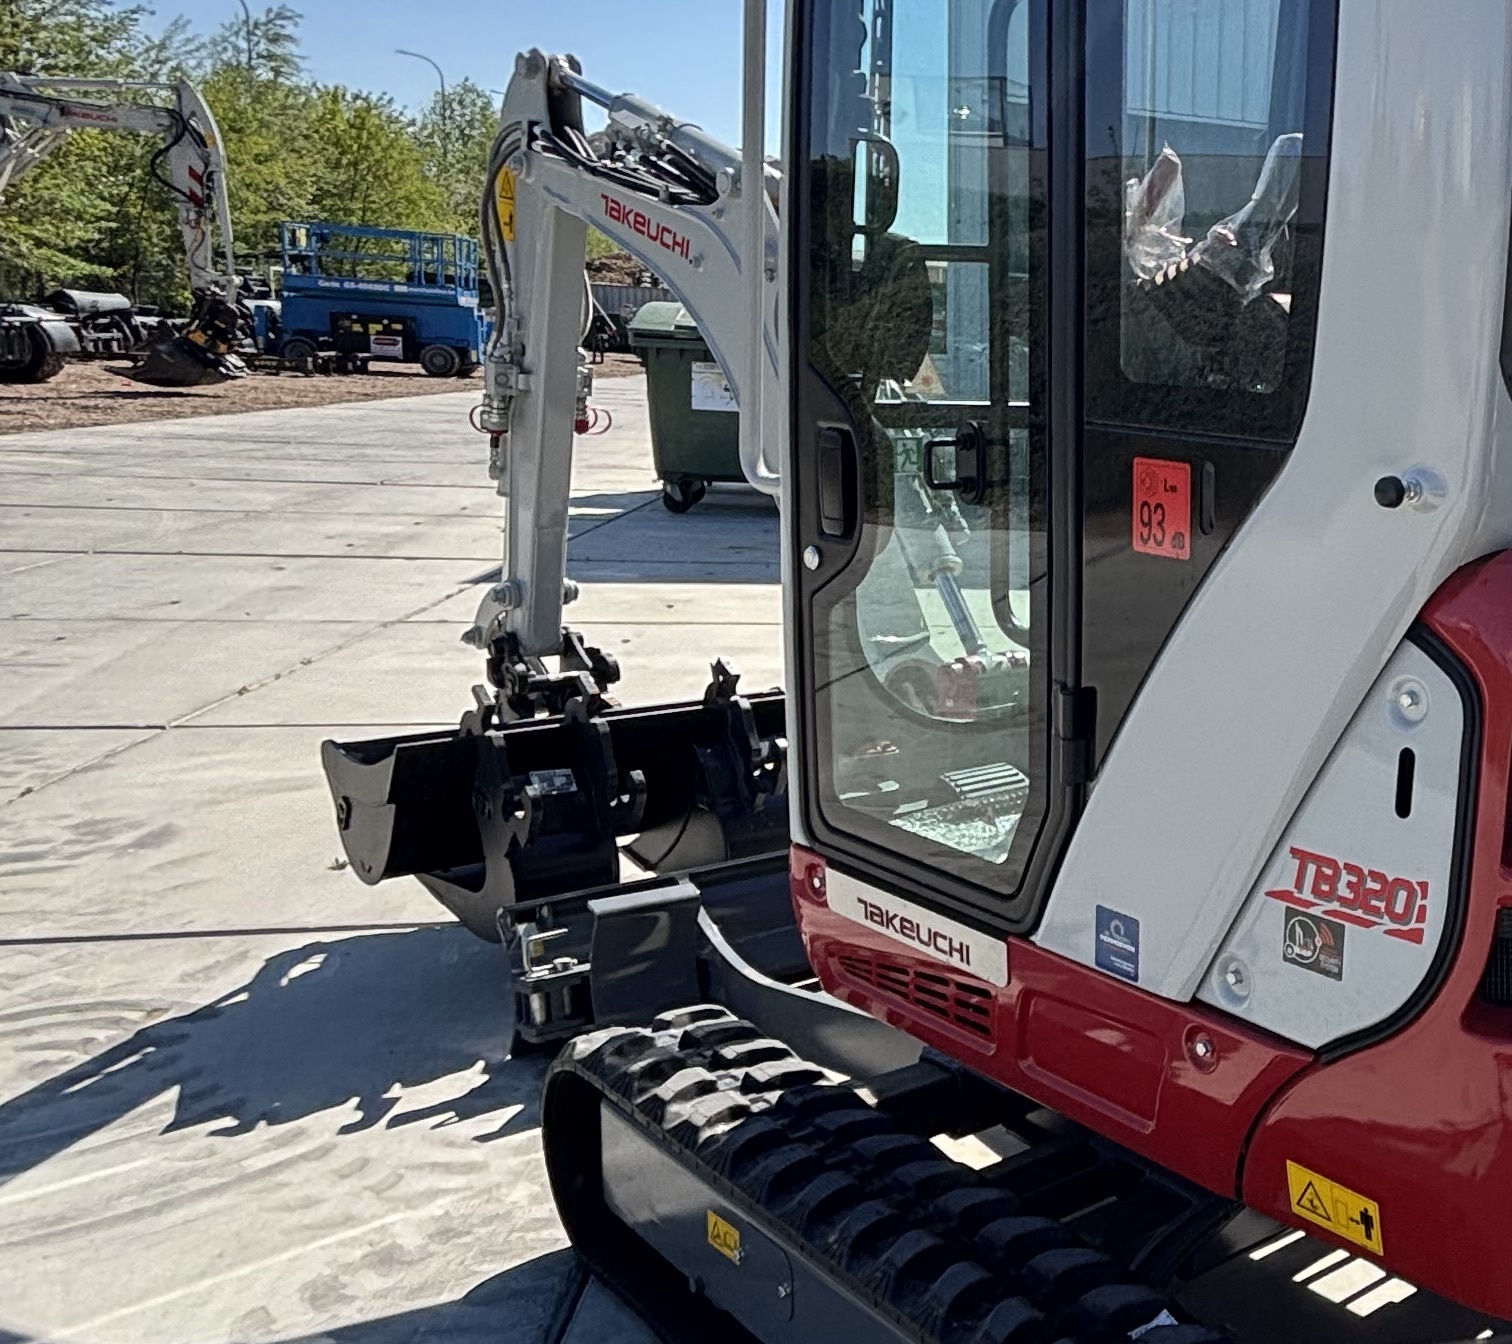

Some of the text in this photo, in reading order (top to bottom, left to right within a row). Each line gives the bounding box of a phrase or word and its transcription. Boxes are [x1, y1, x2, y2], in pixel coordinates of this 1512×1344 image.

[601, 193, 690, 260] TAKEUCHI
[1140, 500, 1165, 547] 93
[857, 897, 971, 966] TAKEUCHI
